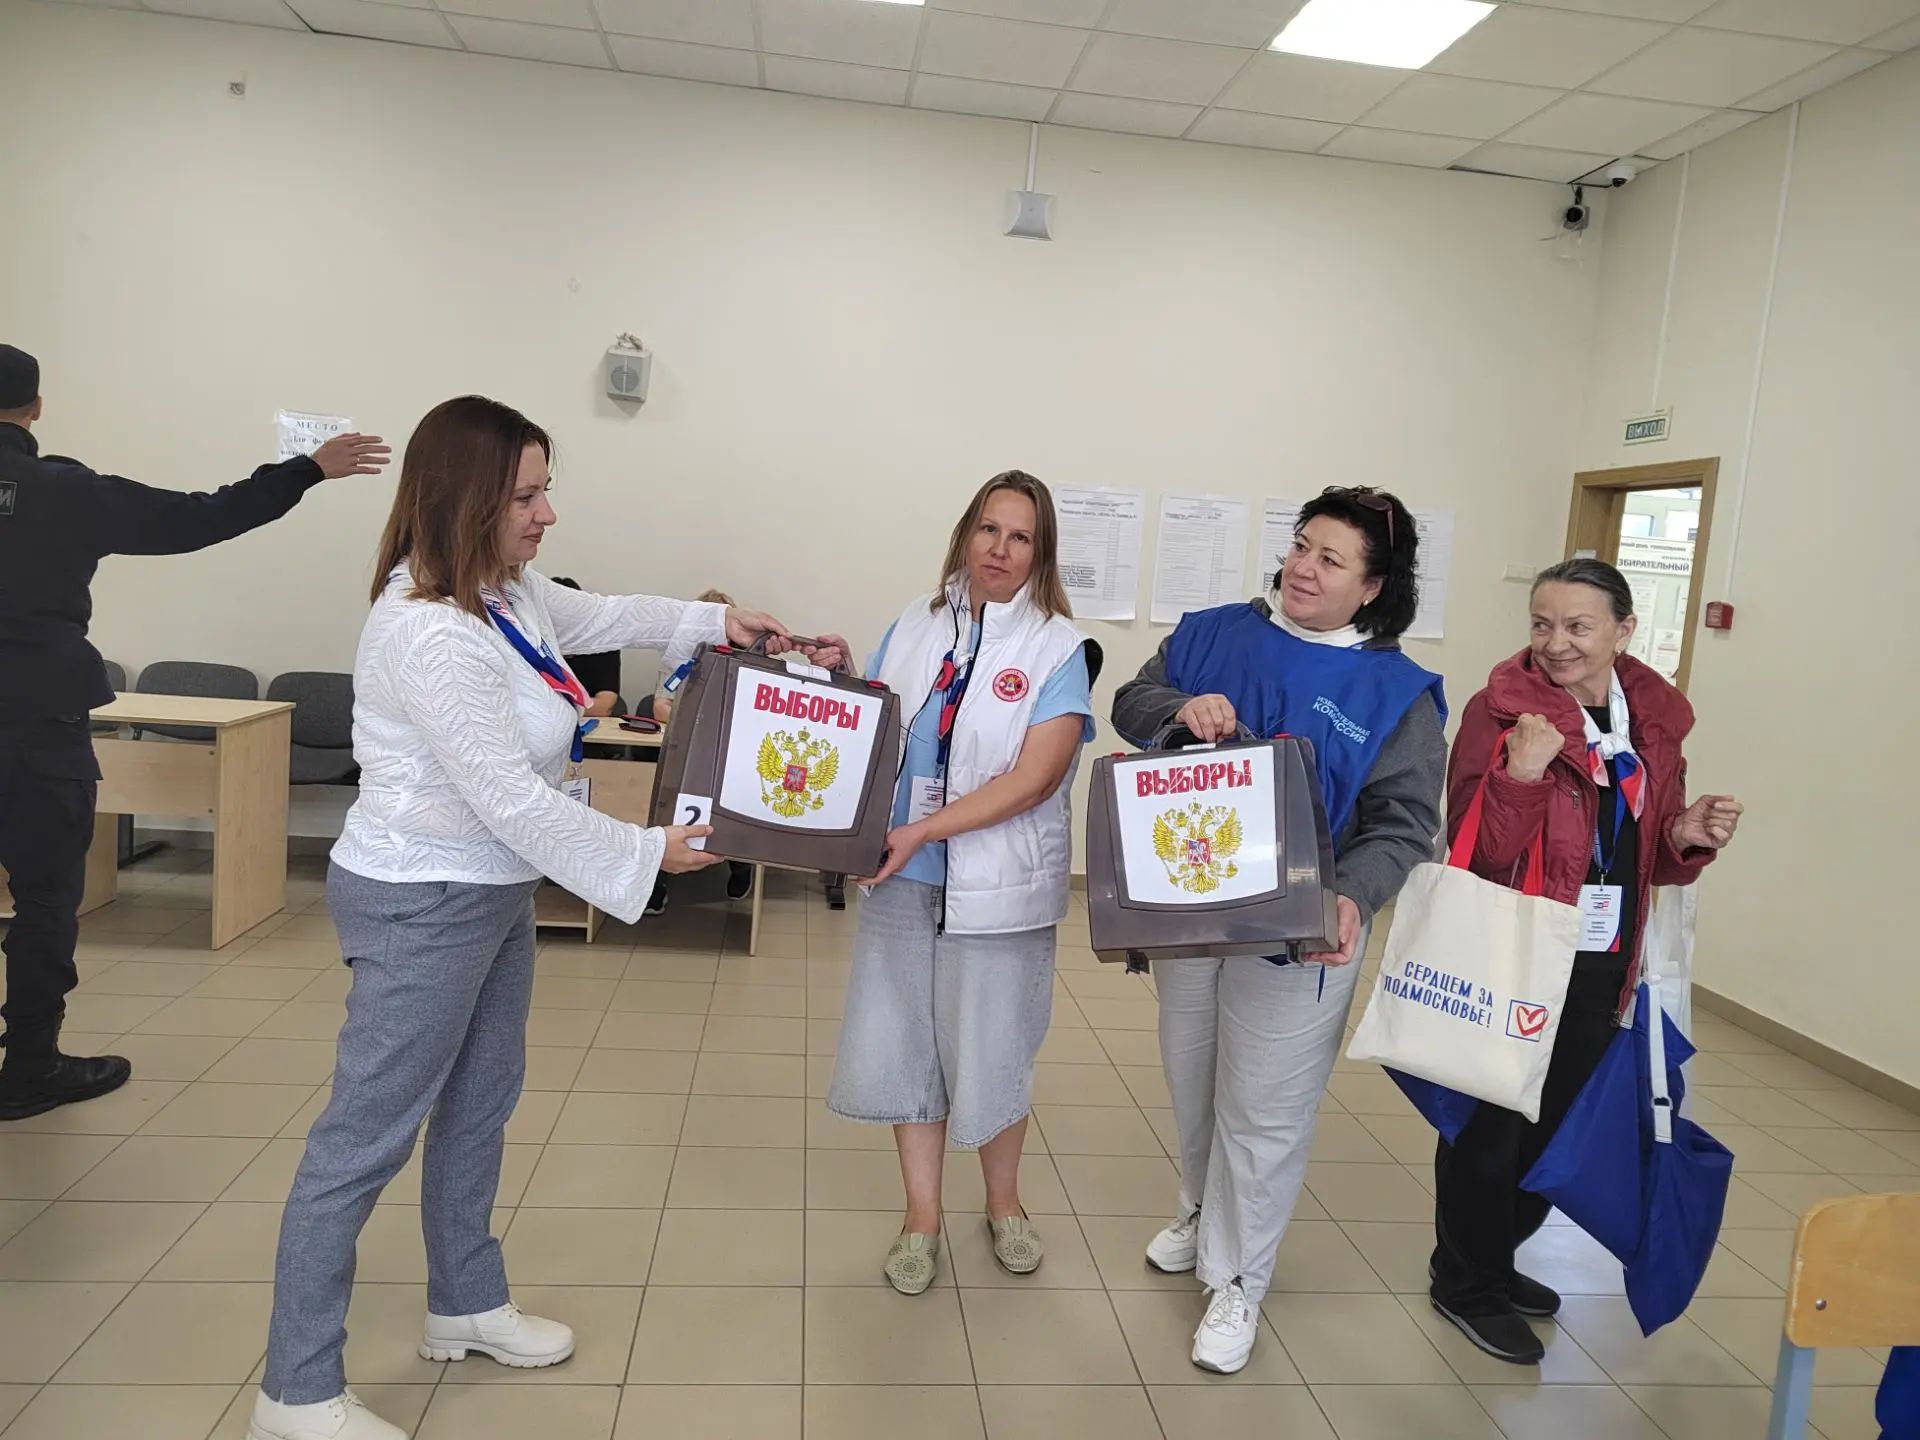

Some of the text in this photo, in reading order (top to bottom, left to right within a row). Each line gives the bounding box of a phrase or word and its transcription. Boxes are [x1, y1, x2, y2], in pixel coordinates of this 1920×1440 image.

[296, 420, 338, 431] МЕСТО
[1627, 419, 1665, 438] ВЫХОД
[1617, 559, 1690, 572] ЗБИРАТЕЛЬНЫЙ
[754, 683, 861, 731] ВЫБОРЫ
[1136, 759, 1252, 797] ВЫБОРЫ
[685, 805, 701, 826] 2
[1404, 961, 1494, 1008] СЕРДЦЕМ ЗА
[1384, 975, 1492, 1028] ПОДМОСКОВЬЕ!
